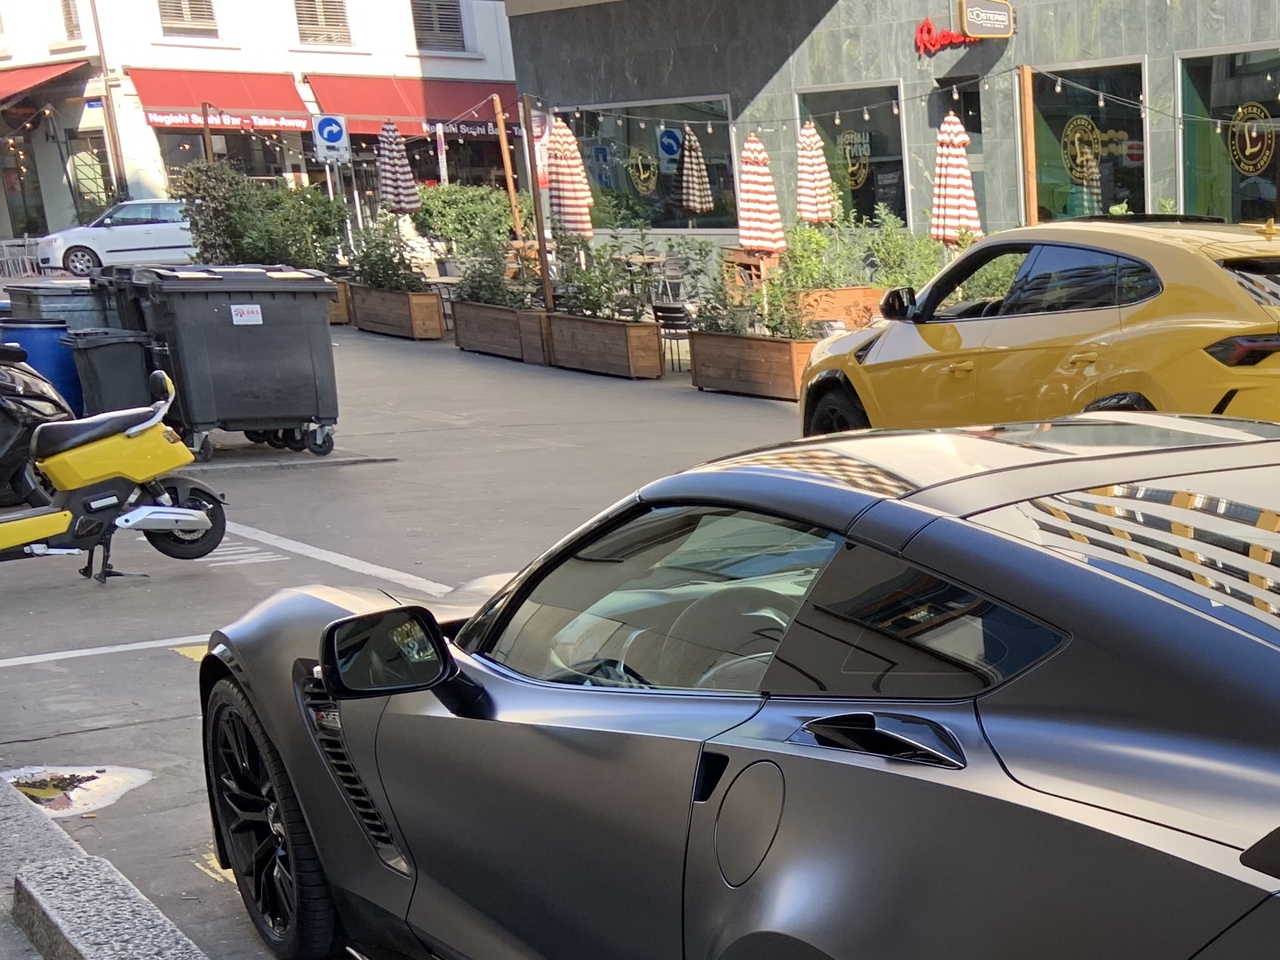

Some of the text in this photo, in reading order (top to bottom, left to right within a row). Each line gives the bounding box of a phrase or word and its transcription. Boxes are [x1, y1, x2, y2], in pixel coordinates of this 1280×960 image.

[148, 113, 189, 126] Negishi
[222, 114, 242, 126] Bar
[251, 115, 307, 129] Take-Away
